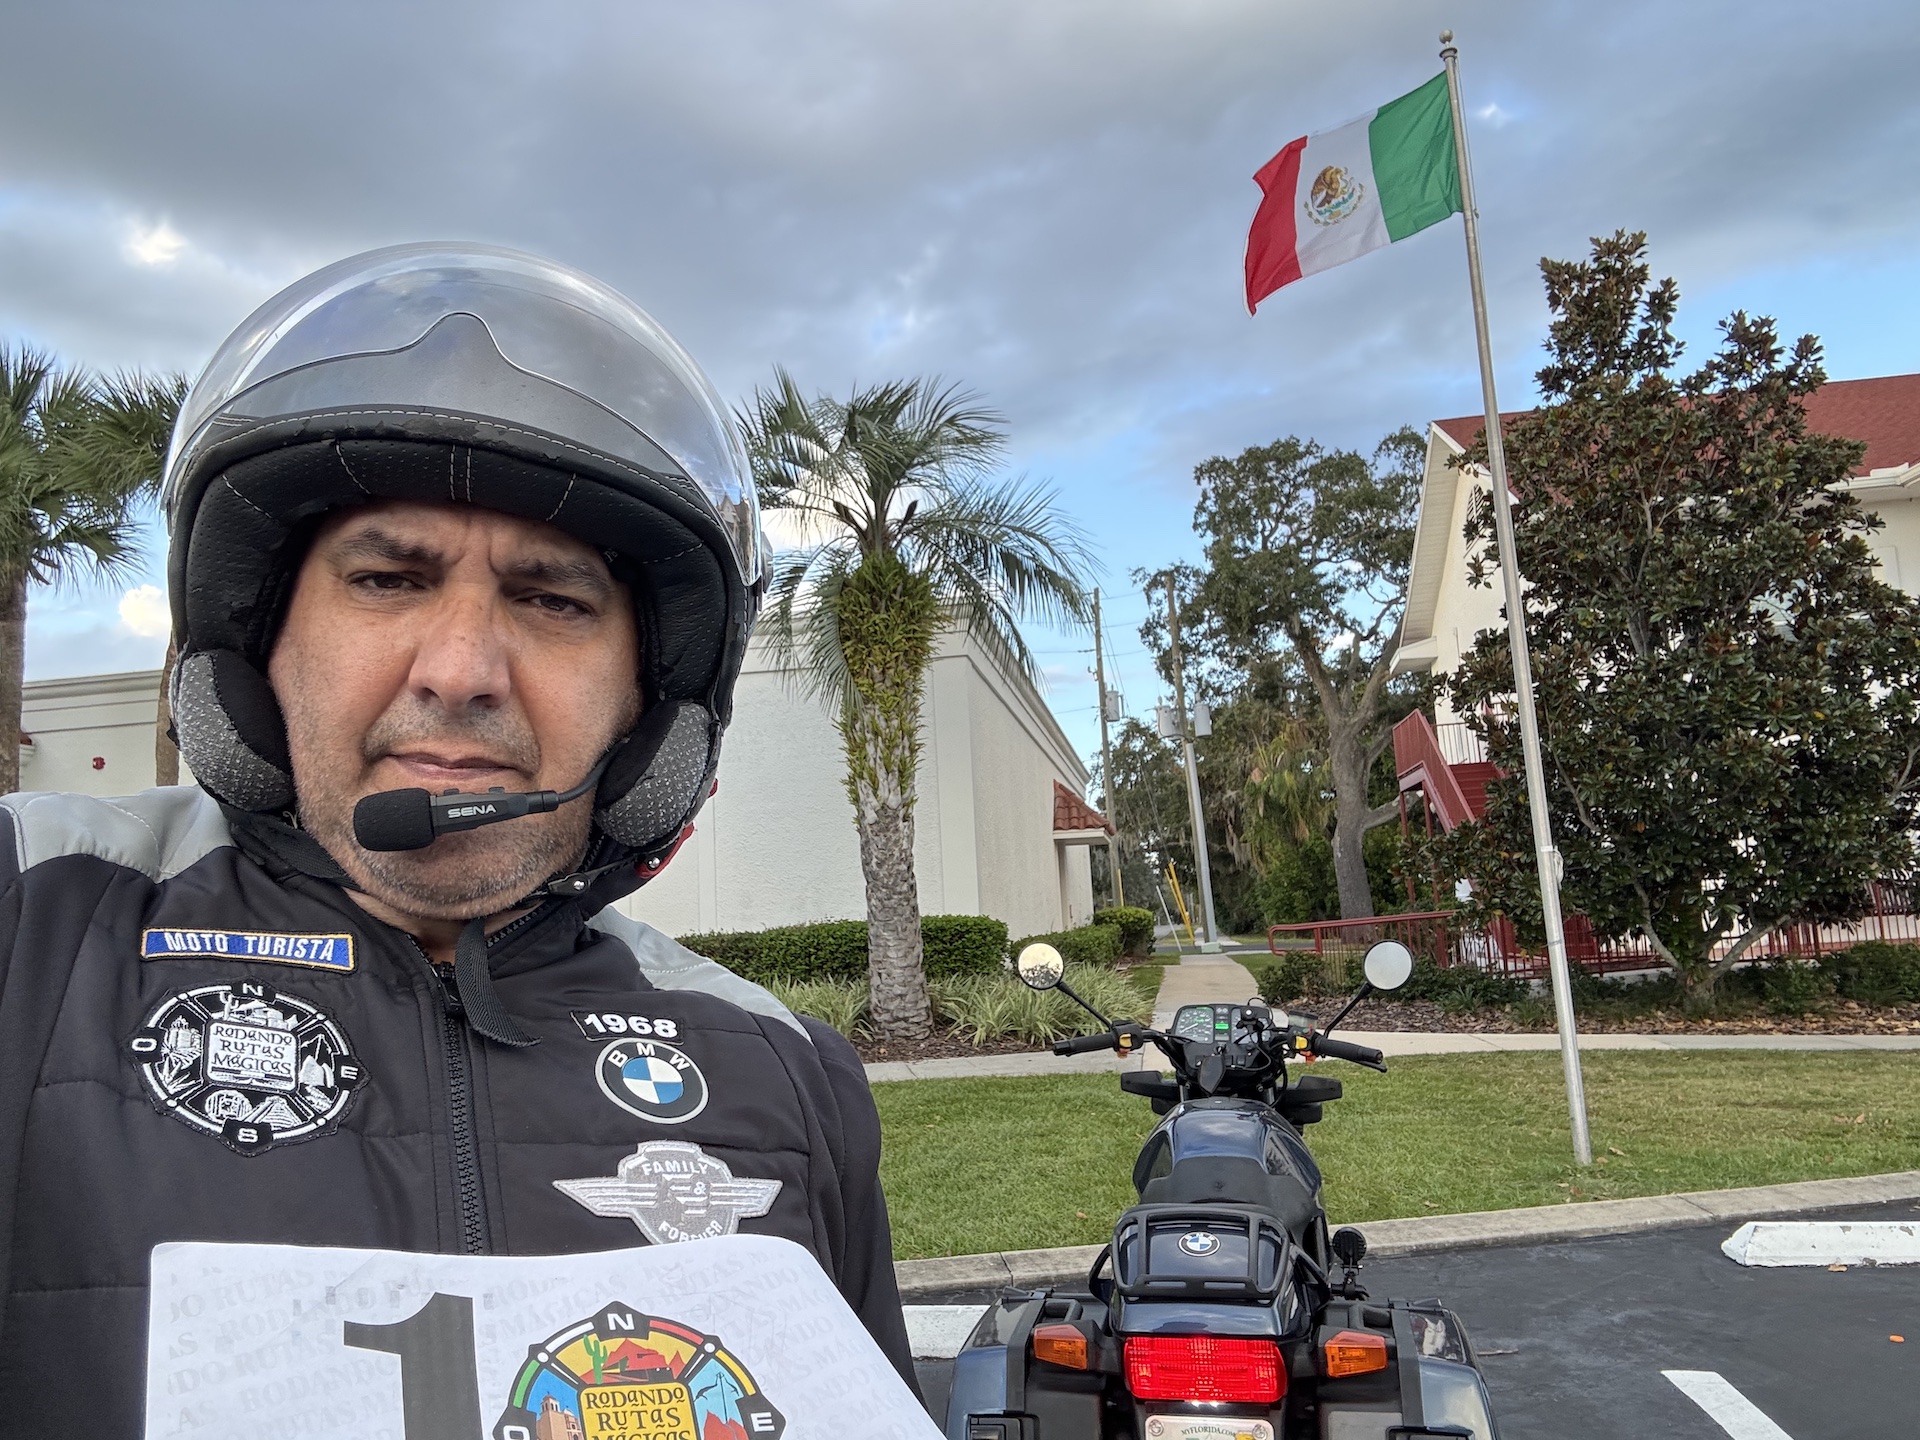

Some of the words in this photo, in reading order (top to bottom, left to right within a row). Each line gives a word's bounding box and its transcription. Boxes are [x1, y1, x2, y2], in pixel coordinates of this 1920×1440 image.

[448, 804, 496, 818] SENA
[164, 933, 229, 952] MOTO
[244, 937, 335, 961] TURISTA
[242, 983, 263, 996] N
[584, 1013, 678, 1037] 1968
[212, 1025, 293, 1048] RODANDO
[220, 1039, 286, 1061] RUTAS
[607, 1042, 691, 1071] BMW
[341, 1066, 359, 1080] E
[237, 1128, 258, 1143] S
[641, 1159, 709, 1176] FAMILY
[607, 1312, 635, 1331] N
[344, 1291, 485, 1440] 1
[585, 1387, 685, 1410] RODANDO
[596, 1407, 682, 1432] RUTAS
[749, 1411, 775, 1432] E
